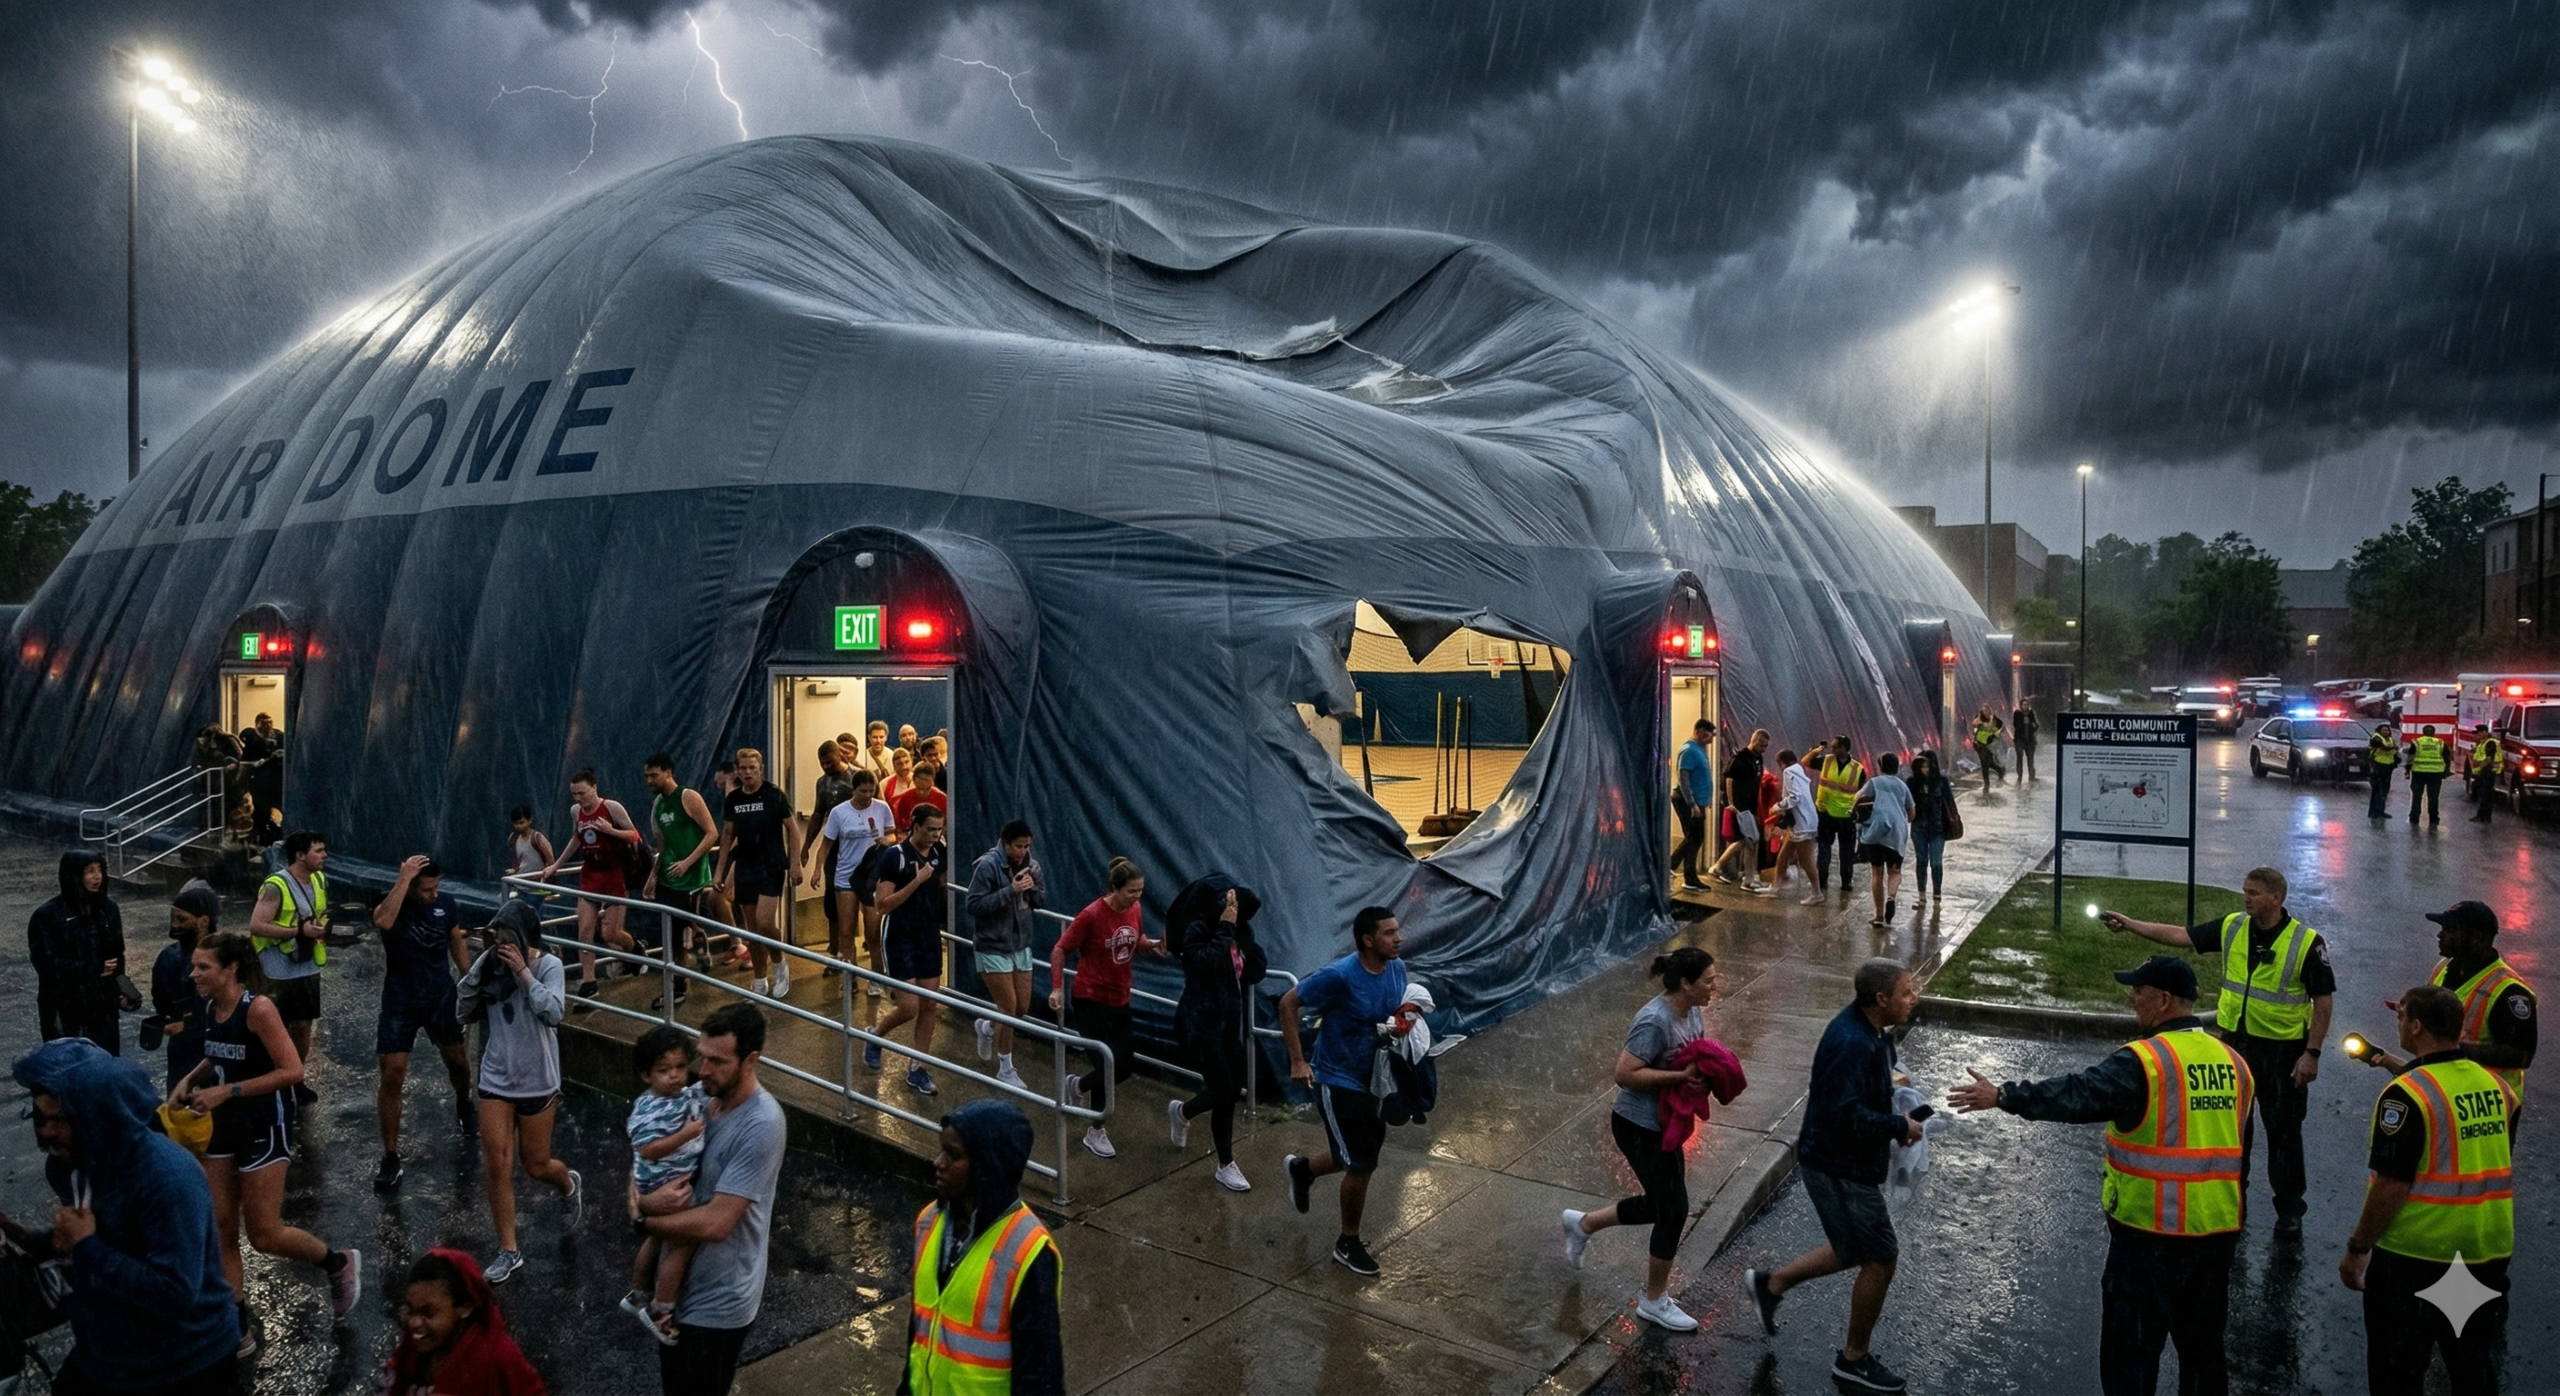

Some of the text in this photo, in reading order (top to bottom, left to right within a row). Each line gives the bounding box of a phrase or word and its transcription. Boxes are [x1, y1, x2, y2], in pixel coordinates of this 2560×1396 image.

[150, 367, 636, 531] AIR DOME
[842, 613, 876, 644] EXIT
[2073, 718, 2180, 732] CENTRAL COMMUNITY
[2187, 1063, 2237, 1091] STAFF
[2454, 1089, 2504, 1122] STAFF
